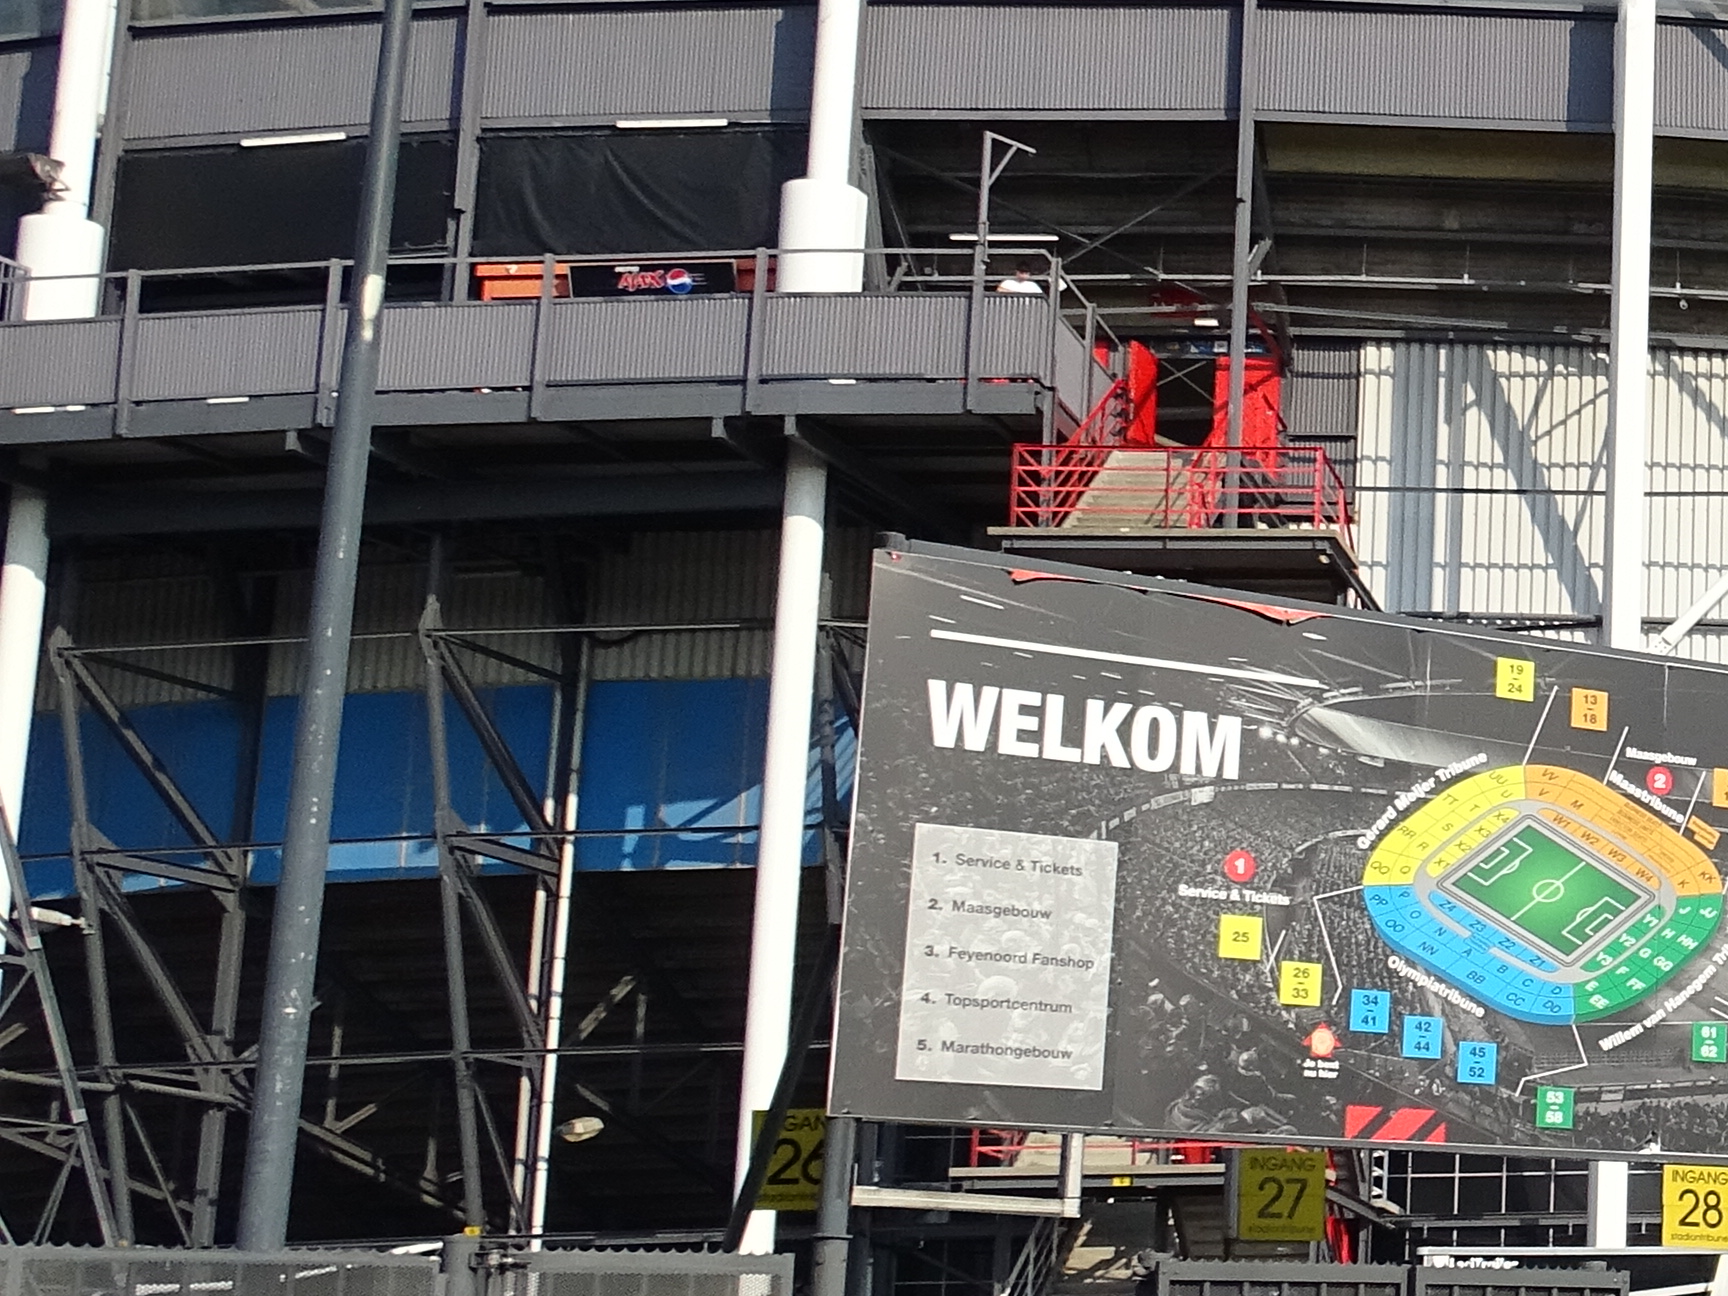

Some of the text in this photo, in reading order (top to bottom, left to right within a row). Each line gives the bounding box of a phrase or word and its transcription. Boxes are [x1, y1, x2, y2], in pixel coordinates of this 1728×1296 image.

[1509, 665, 1524, 675] 19
[1508, 683, 1523, 694] 24
[1583, 694, 1598, 705] 13
[1582, 713, 1597, 724] 18
[927, 678, 1242, 780] WELKOM
[1625, 746, 1698, 766] Maasgebouw
[1653, 773, 1667, 789] 2
[1356, 753, 1488, 850] Gerard Meijer Tribune
[1609, 769, 1685, 824] Maastribune
[931, 852, 1083, 877] 1. Service & Tickets
[1235, 858, 1246, 874] 1
[1178, 884, 1291, 906] Service & Tickets
[927, 898, 1053, 921] 2. Maasgebouw
[1231, 931, 1250, 943] 25
[924, 945, 1095, 972] 3. Feyenoord Fanshop
[1292, 967, 1310, 979] 26
[1291, 988, 1309, 1000] 33
[1387, 955, 1486, 1018] Olympiatribune
[920, 992, 1073, 1016] 4. Topsportcentrum
[1362, 994, 1379, 1006] 34
[1598, 1024, 1644, 1052] Willem
[1642, 1008, 1666, 1030] van
[1664, 964, 1717, 1013] Hanegem
[1361, 1015, 1378, 1027] 41
[1414, 1021, 1432, 1033] 42
[916, 1038, 1074, 1063] 5. Marathongebouw
[1413, 1041, 1431, 1053] 44
[1469, 1047, 1486, 1058] 45
[1468, 1066, 1485, 1078] 52
[766, 1138, 825, 1185] 26
[1249, 1156, 1316, 1172] INGANG
[1672, 1169, 1728, 1185] INGANG
[1258, 1176, 1309, 1219] 27
[1678, 1188, 1723, 1229] 28
[1671, 1232, 1728, 1243] stadiontribune
